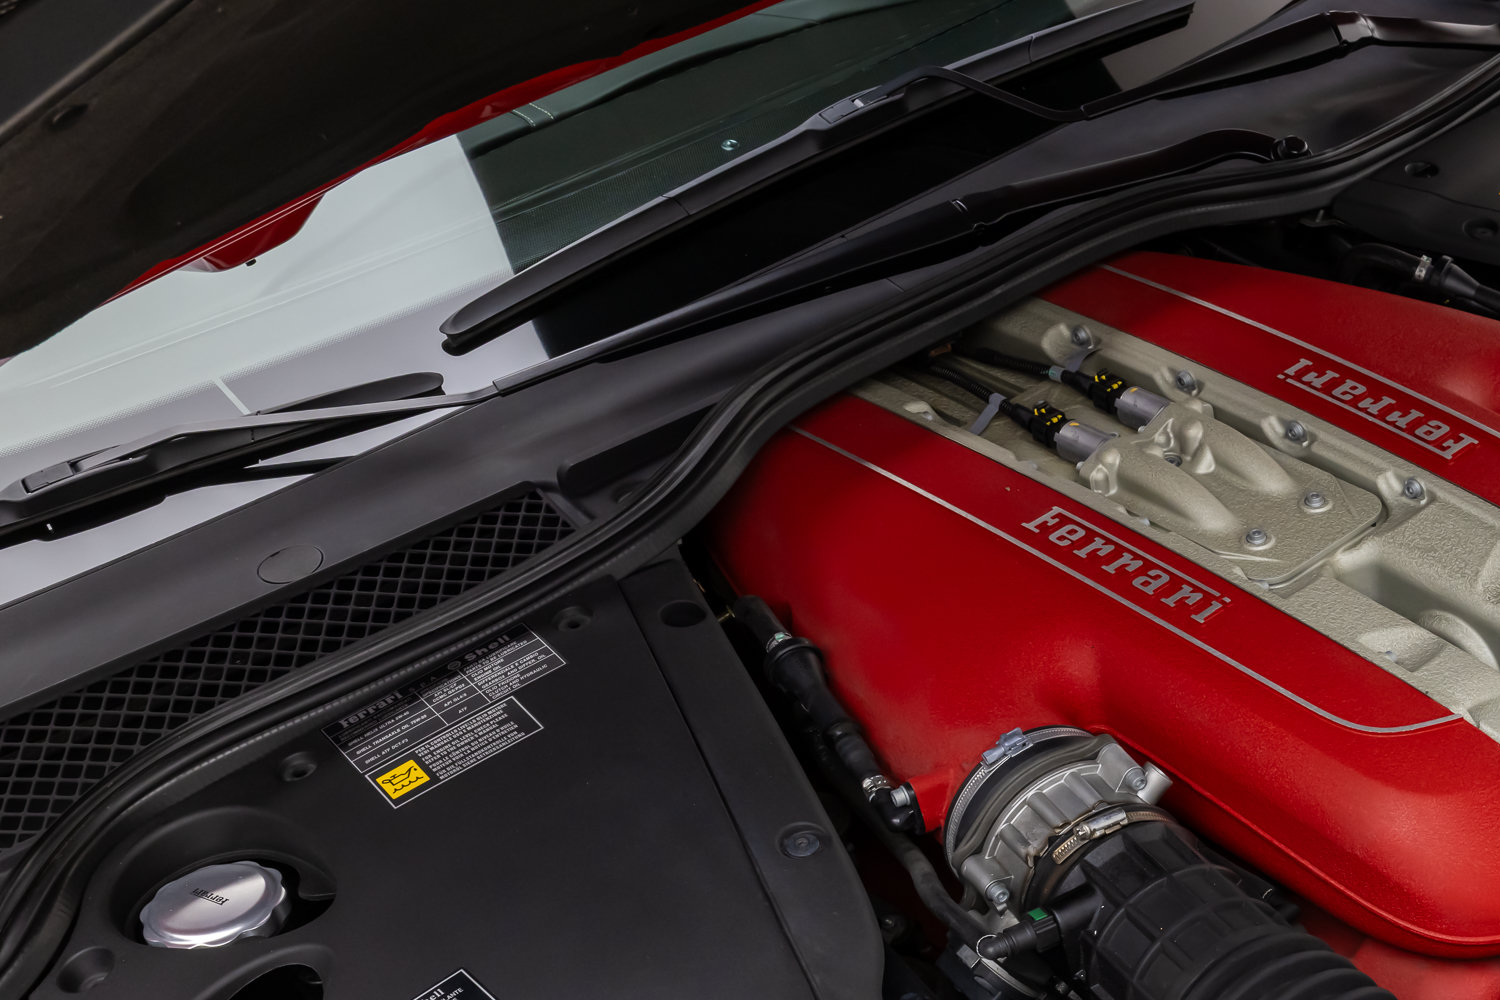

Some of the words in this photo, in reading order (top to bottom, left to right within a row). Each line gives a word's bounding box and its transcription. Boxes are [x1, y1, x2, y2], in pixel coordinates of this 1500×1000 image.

[1277, 358, 1479, 460] Ferrari
[1021, 506, 1232, 624] Ferrari
[463, 635, 510, 661] Shell
[339, 691, 402, 727] Ferrari
[191, 888, 229, 906] Ferrari
